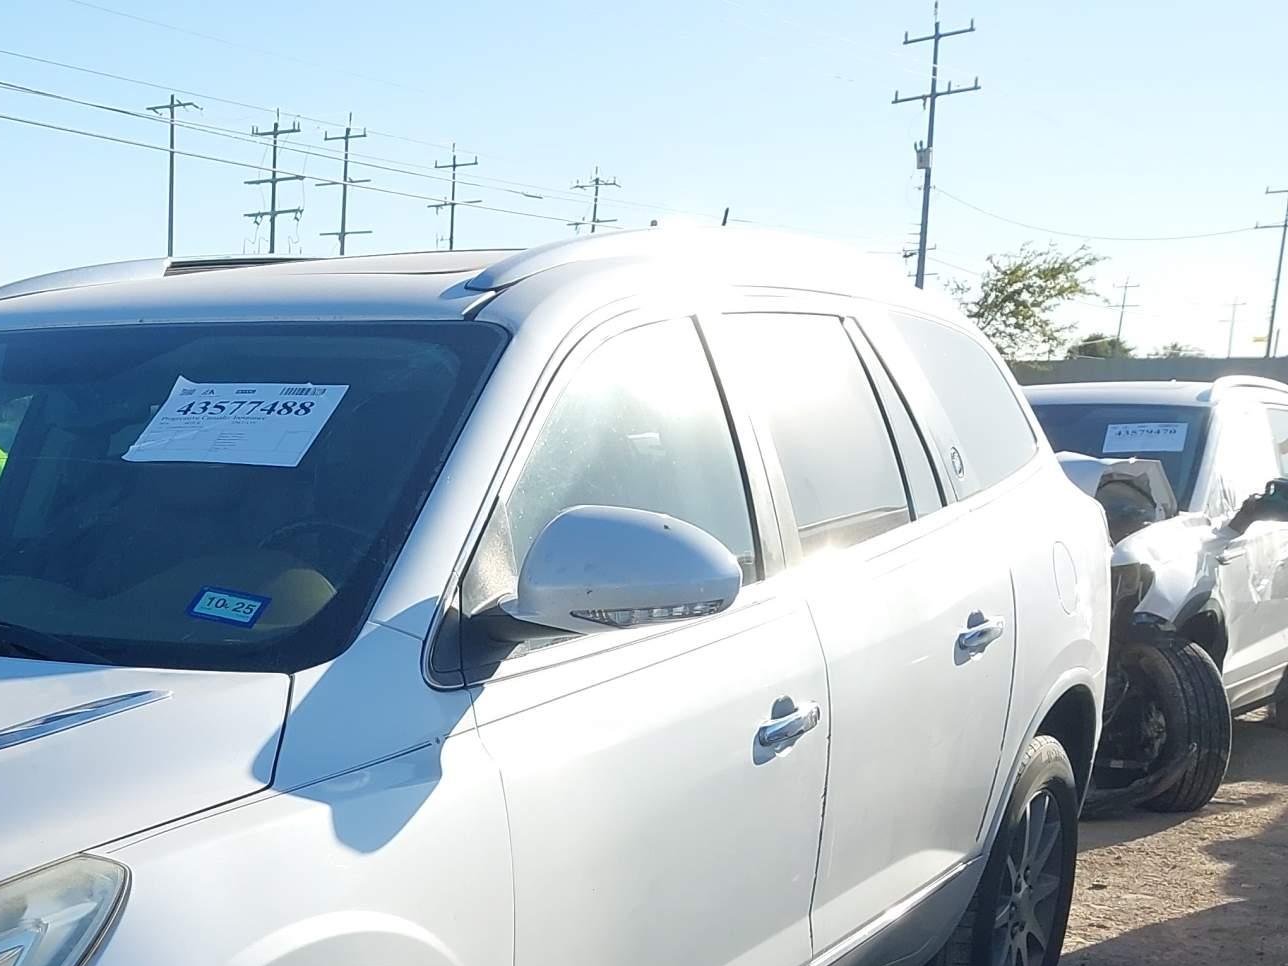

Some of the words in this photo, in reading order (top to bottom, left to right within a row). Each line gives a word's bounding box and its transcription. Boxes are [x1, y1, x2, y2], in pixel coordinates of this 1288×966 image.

[176, 400, 315, 416] 43577488
[206, 596, 226, 609] 10
[231, 601, 256, 615] 25
